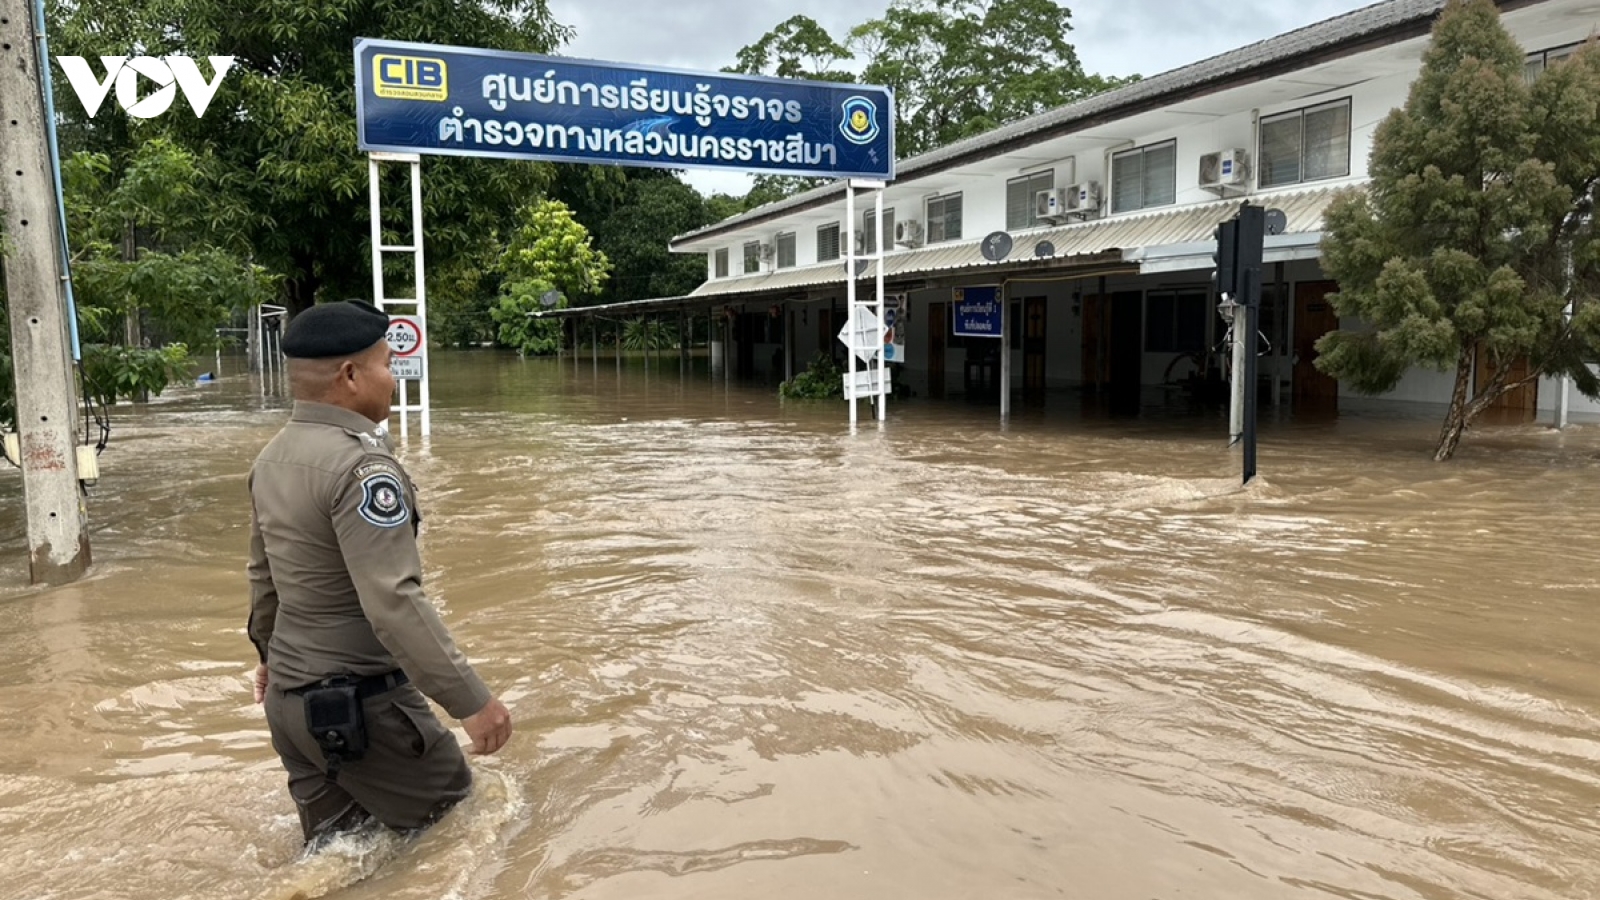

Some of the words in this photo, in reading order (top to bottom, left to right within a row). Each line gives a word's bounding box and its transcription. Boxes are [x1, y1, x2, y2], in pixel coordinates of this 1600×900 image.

[379, 58, 443, 87] CIB
[482, 70, 803, 127] ศูนย์การเรียนรู้จราจร
[438, 106, 837, 165] ตำรวจทางหลวงนครราชสีมา
